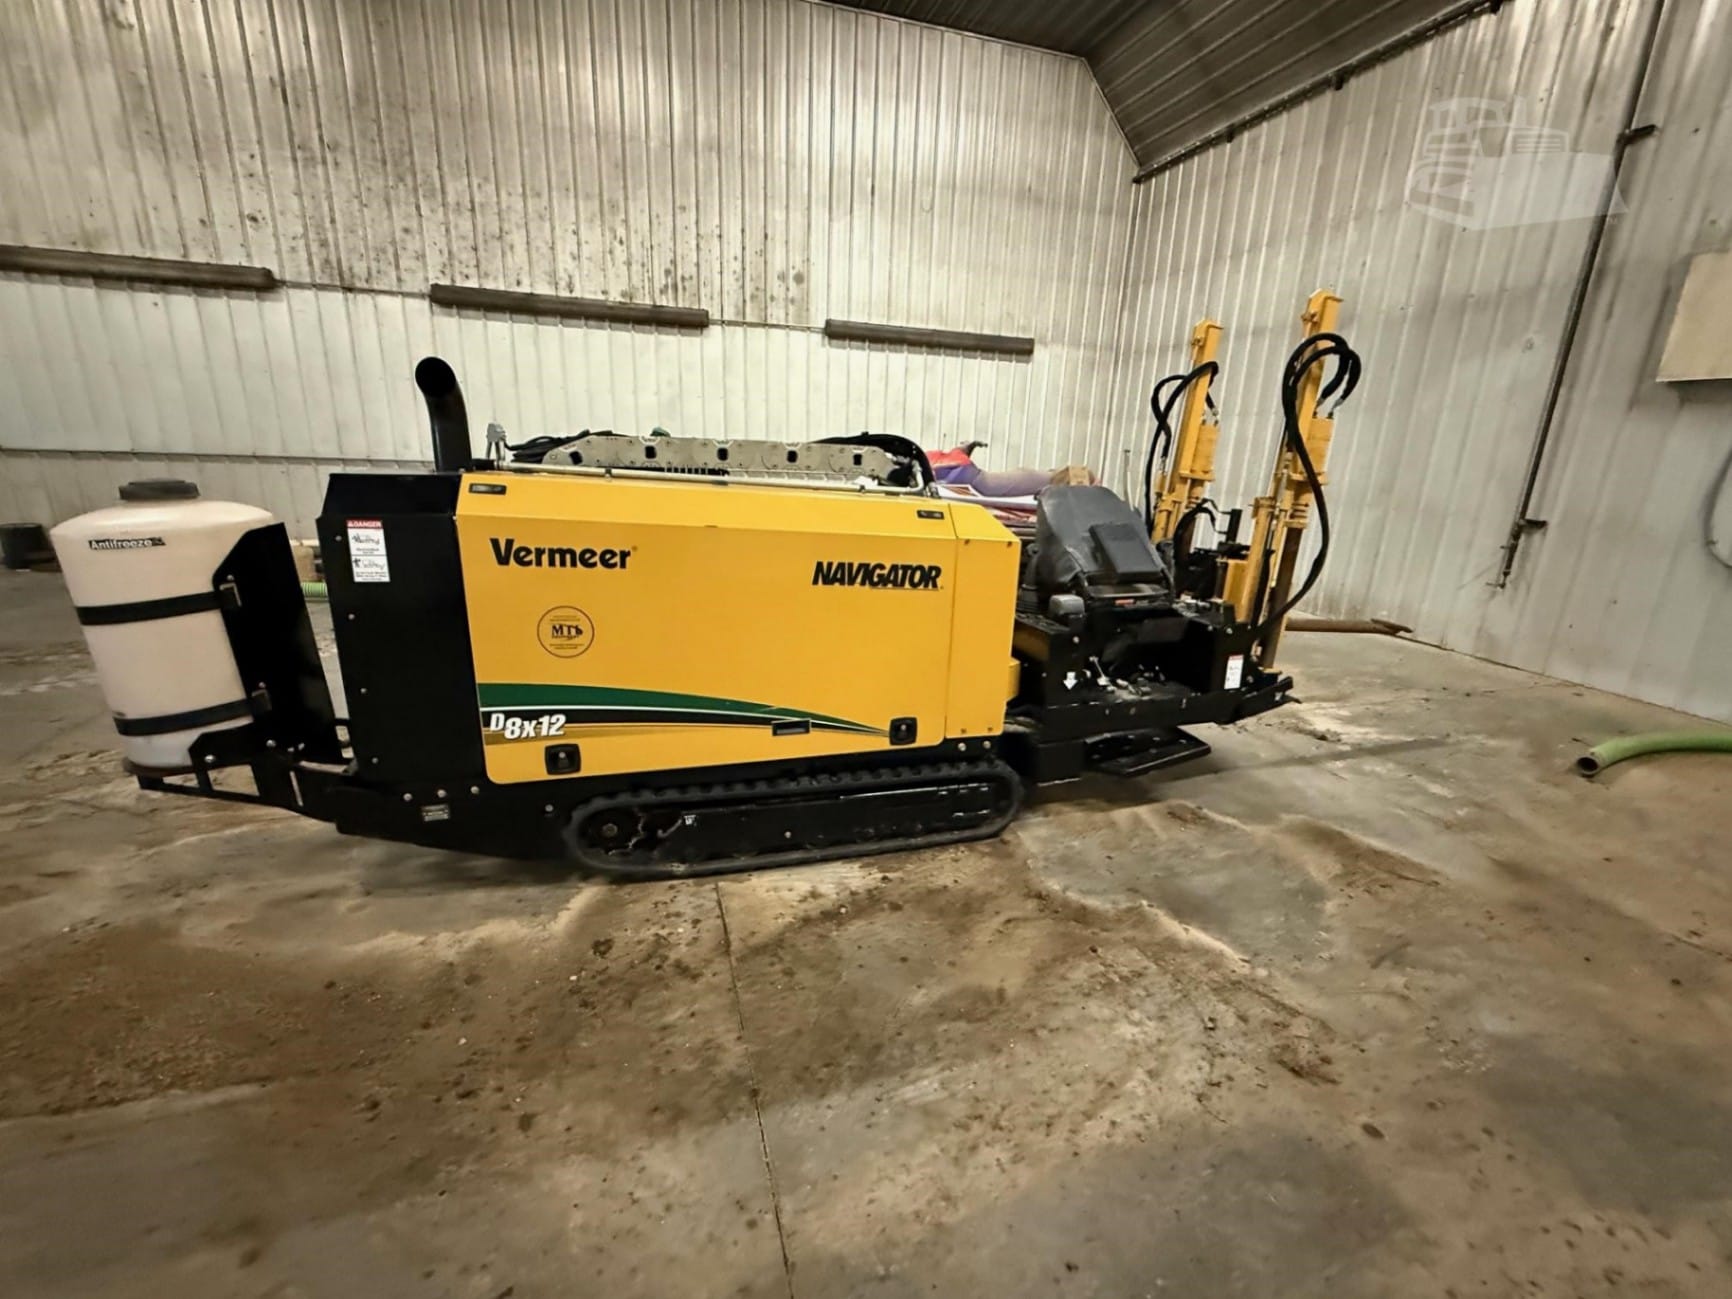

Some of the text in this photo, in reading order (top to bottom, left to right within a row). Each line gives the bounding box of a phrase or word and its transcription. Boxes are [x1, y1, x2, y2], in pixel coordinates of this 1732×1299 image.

[91, 539, 153, 550] Antifreeze
[489, 537, 632, 569] Vermeer
[811, 560, 942, 590] NAVIGATOR
